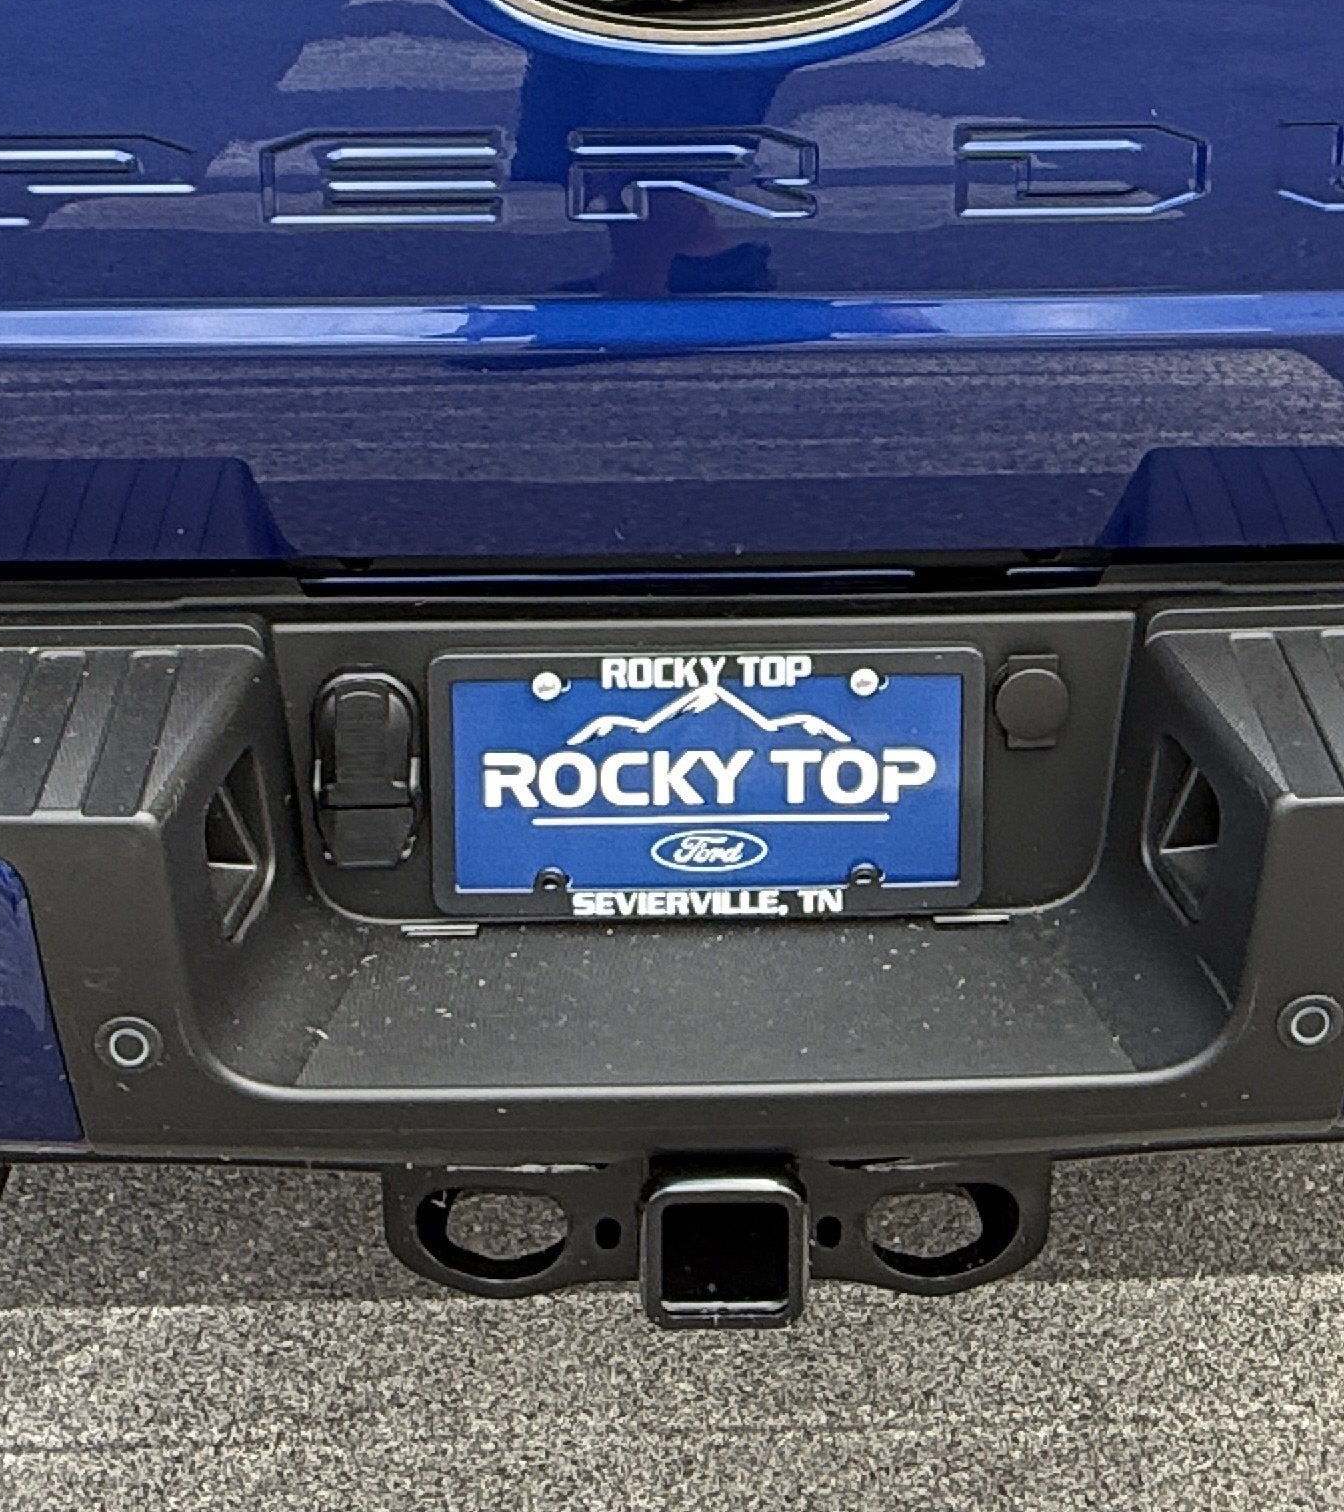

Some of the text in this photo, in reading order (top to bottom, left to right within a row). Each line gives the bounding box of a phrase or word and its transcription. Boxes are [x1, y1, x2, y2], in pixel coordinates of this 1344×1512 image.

[601, 655, 813, 689] ROCKY TOP
[483, 747, 937, 808] ROCKY TOP
[673, 835, 743, 865] Ford
[572, 889, 844, 917] SEVIERVILLE, TN
